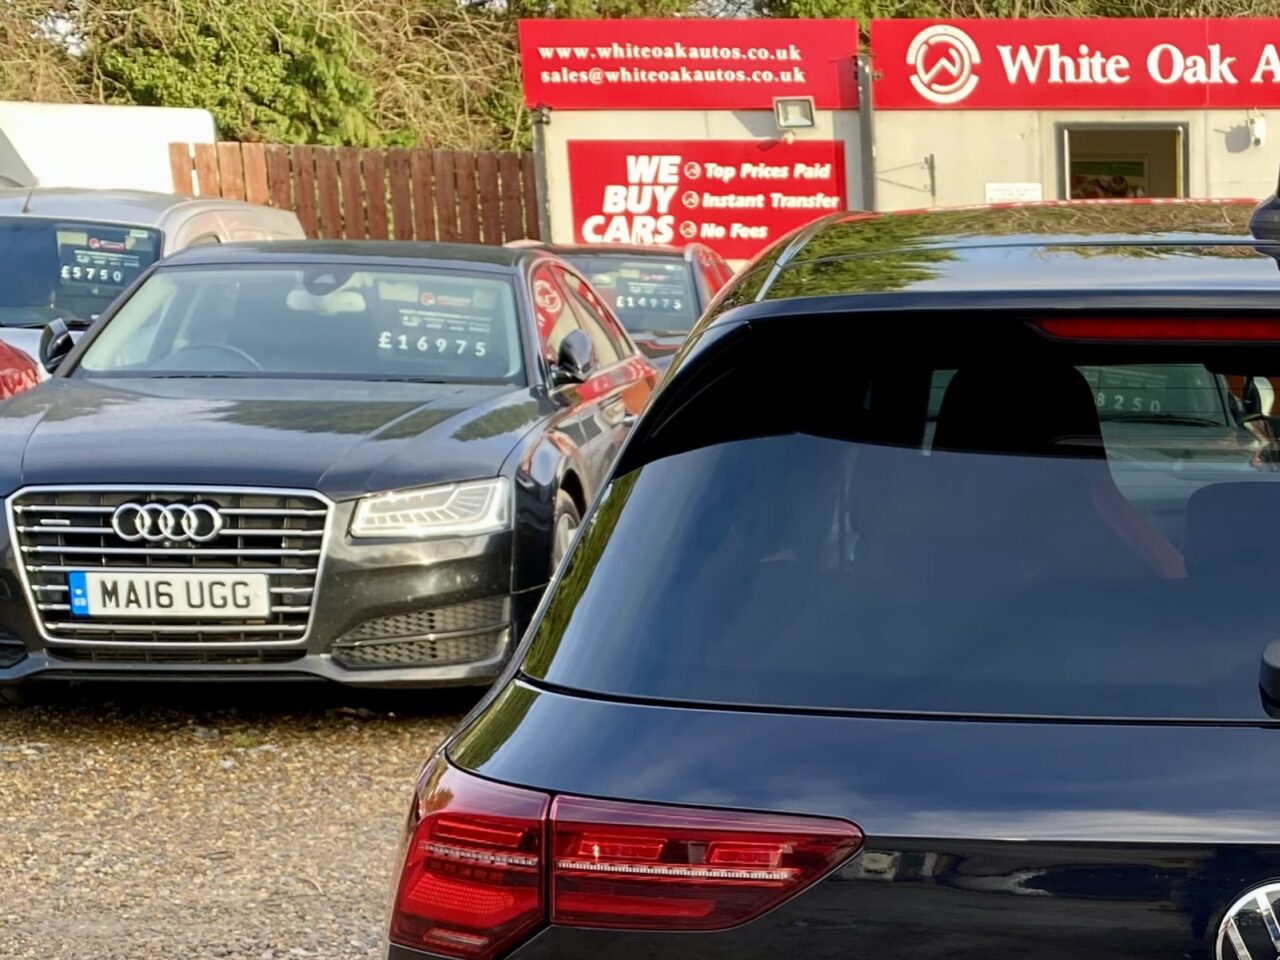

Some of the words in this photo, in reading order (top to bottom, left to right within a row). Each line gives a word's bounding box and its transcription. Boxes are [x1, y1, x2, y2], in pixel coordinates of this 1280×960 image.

[537, 42, 803, 61] www.whiteoakautos.co.uk
[540, 66, 806, 85] sales@whiteoakautos.co.uk
[996, 43, 1131, 85] White
[1146, 43, 1240, 85] Oak
[626, 155, 682, 184] WE
[704, 162, 737, 183] Top
[740, 163, 790, 180] Prices
[793, 162, 832, 179] Paid
[602, 185, 679, 214] BUY
[701, 192, 765, 209] Instant
[769, 193, 840, 209] Transfer
[580, 214, 675, 244] CARS
[699, 222, 726, 239] No
[729, 222, 768, 239] Fees
[60, 264, 122, 282] £5750
[378, 331, 487, 357] £16975
[100, 580, 174, 609] MA16
[186, 580, 251, 609] UGG
